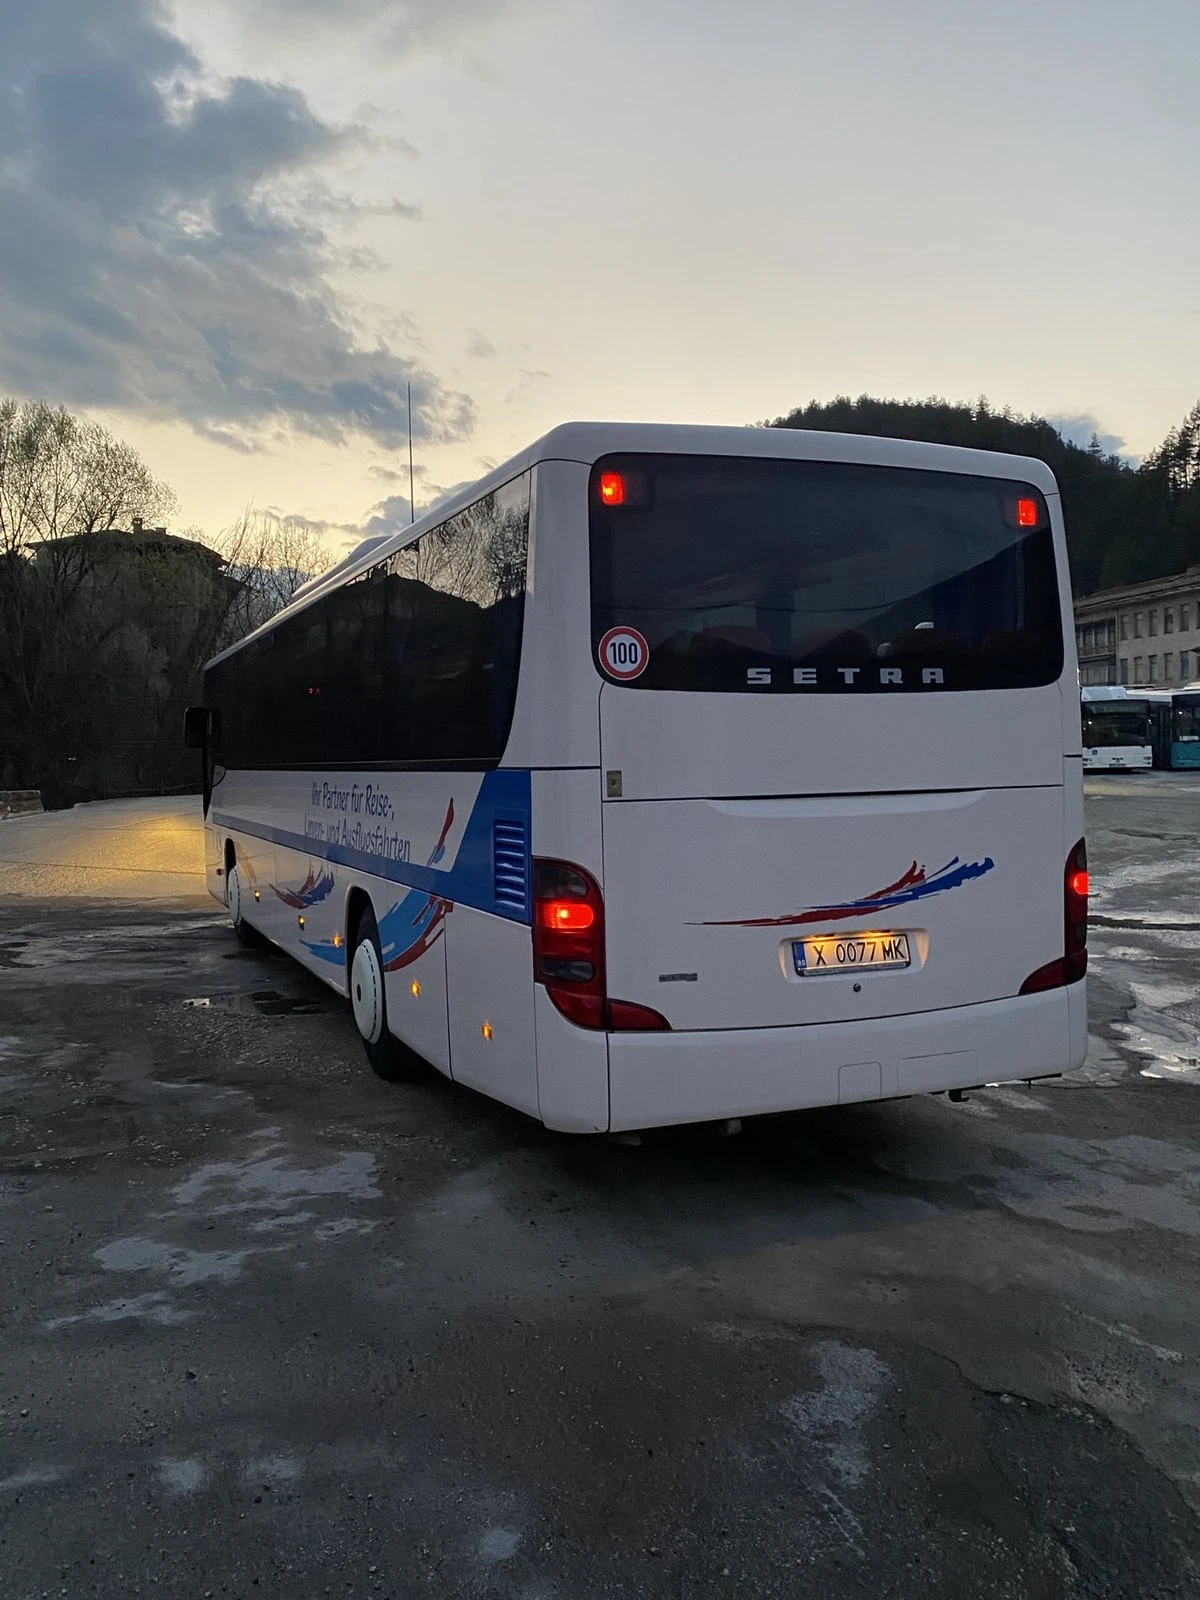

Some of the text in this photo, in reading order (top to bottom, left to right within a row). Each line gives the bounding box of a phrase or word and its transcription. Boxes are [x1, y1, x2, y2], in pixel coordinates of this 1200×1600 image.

[609, 642, 638, 664] 100
[746, 667, 944, 685] SETRA
[322, 782, 349, 812] Partner
[342, 818, 411, 862] Ausflugsfahrten
[813, 938, 905, 965] X 0077 MK
